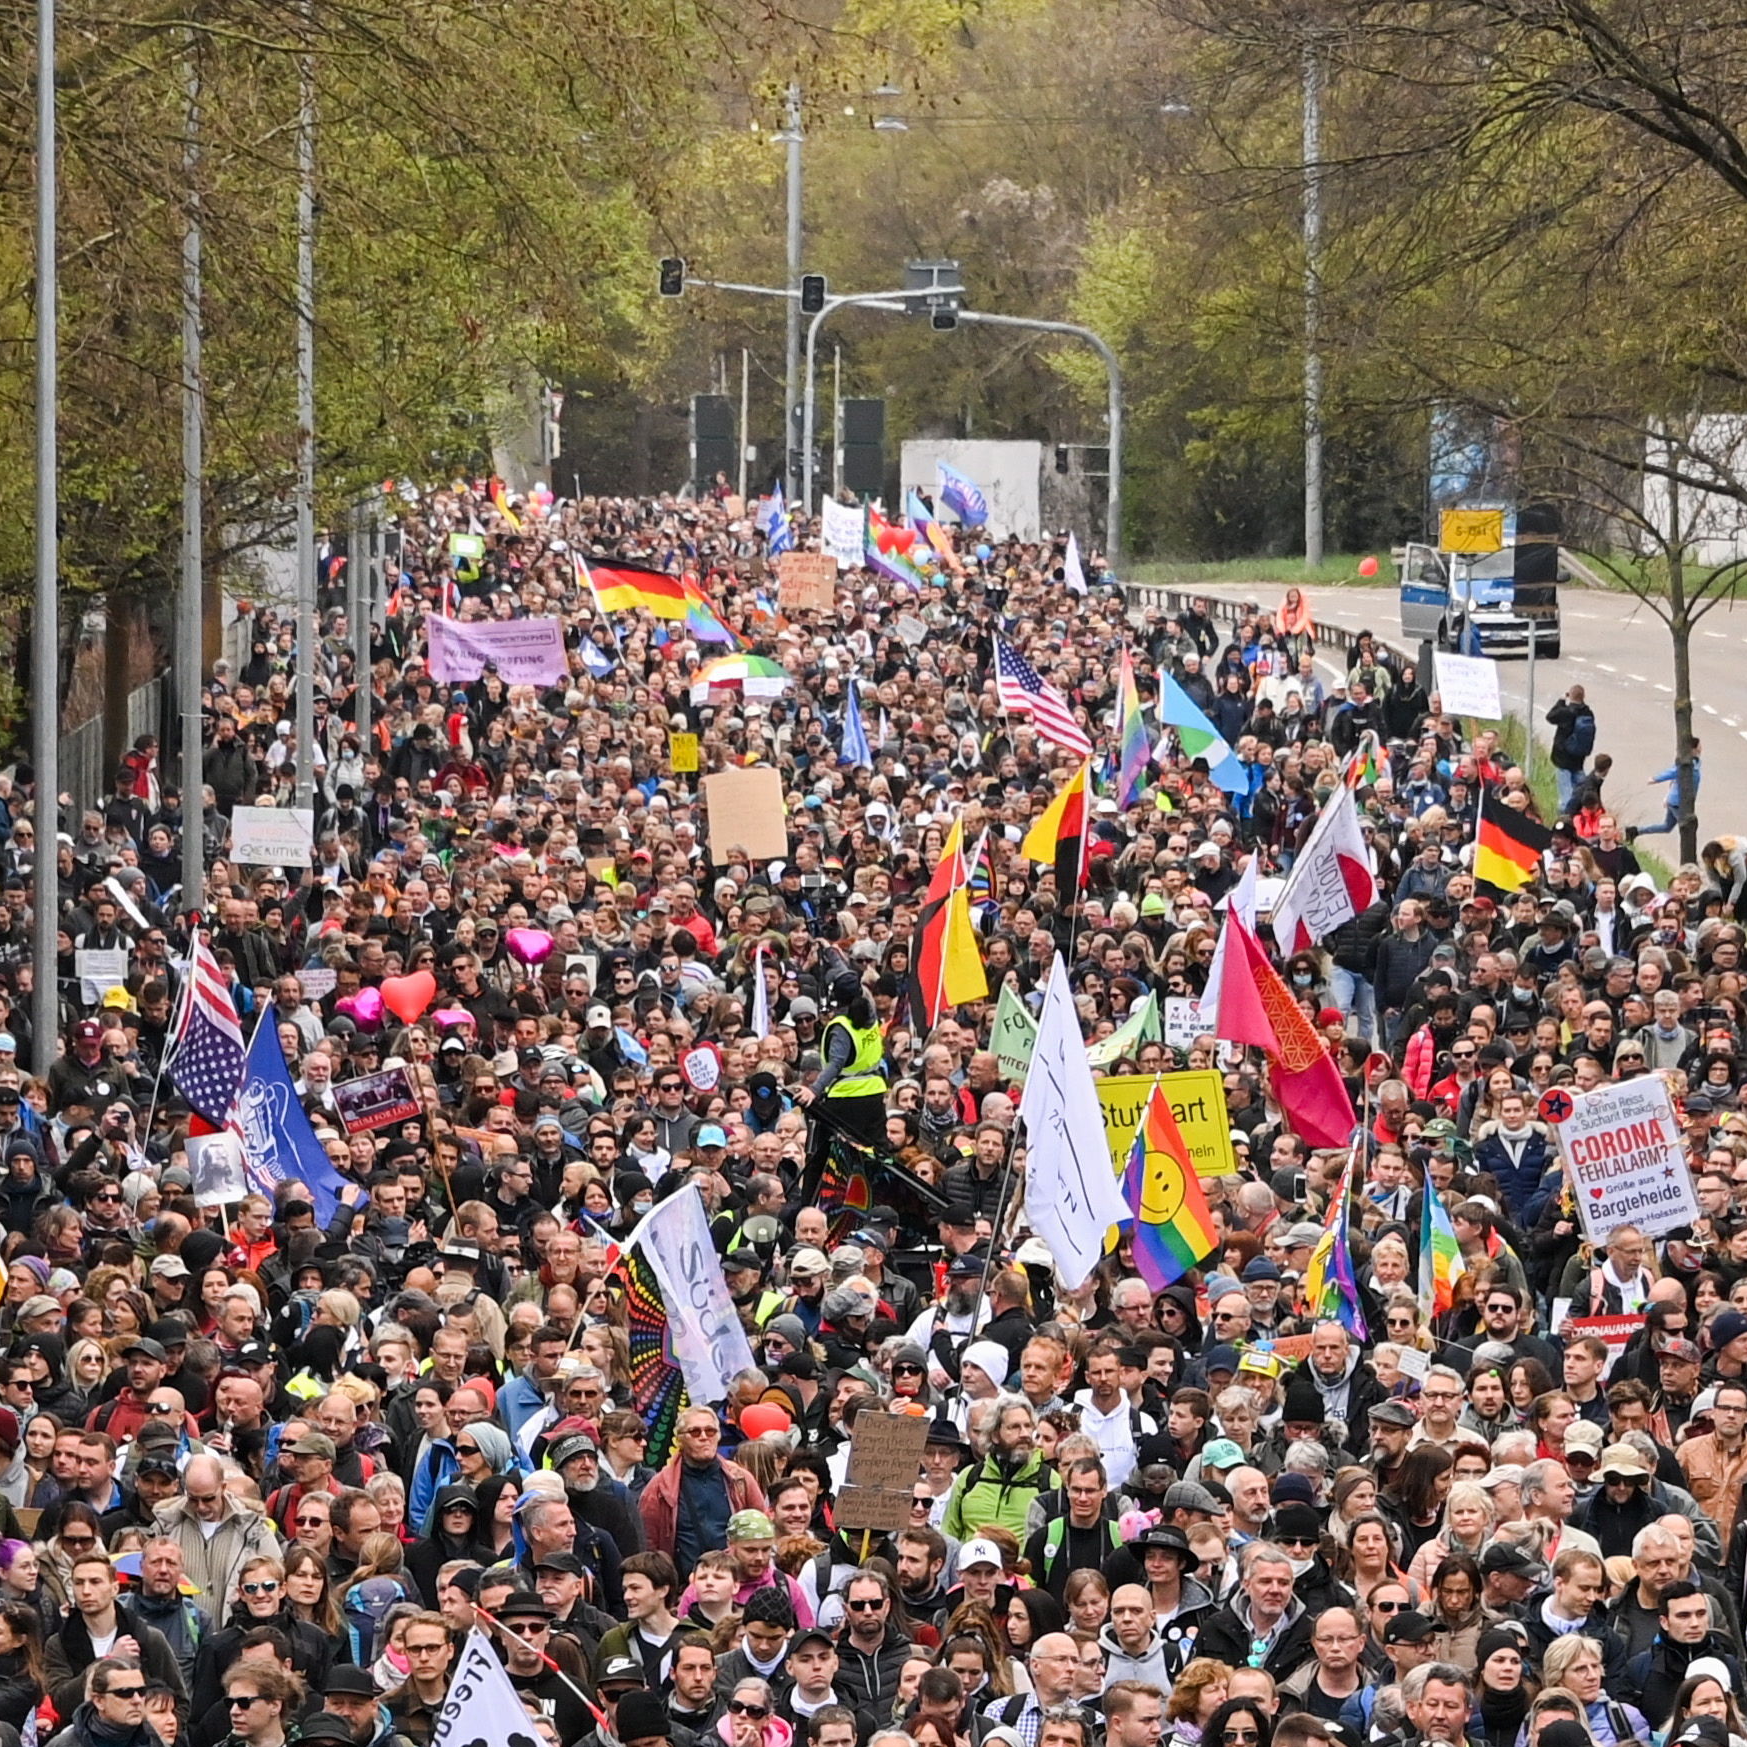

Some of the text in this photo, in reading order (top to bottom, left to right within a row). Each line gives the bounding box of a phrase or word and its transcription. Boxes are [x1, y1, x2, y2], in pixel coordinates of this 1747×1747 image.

[1570, 1119, 1665, 1166] CORONA
[1577, 1145, 1670, 1185] FEHLALARM?
[1589, 1183, 1682, 1220] Bargteheide
[1606, 1175, 1656, 1196] Grüße aus
